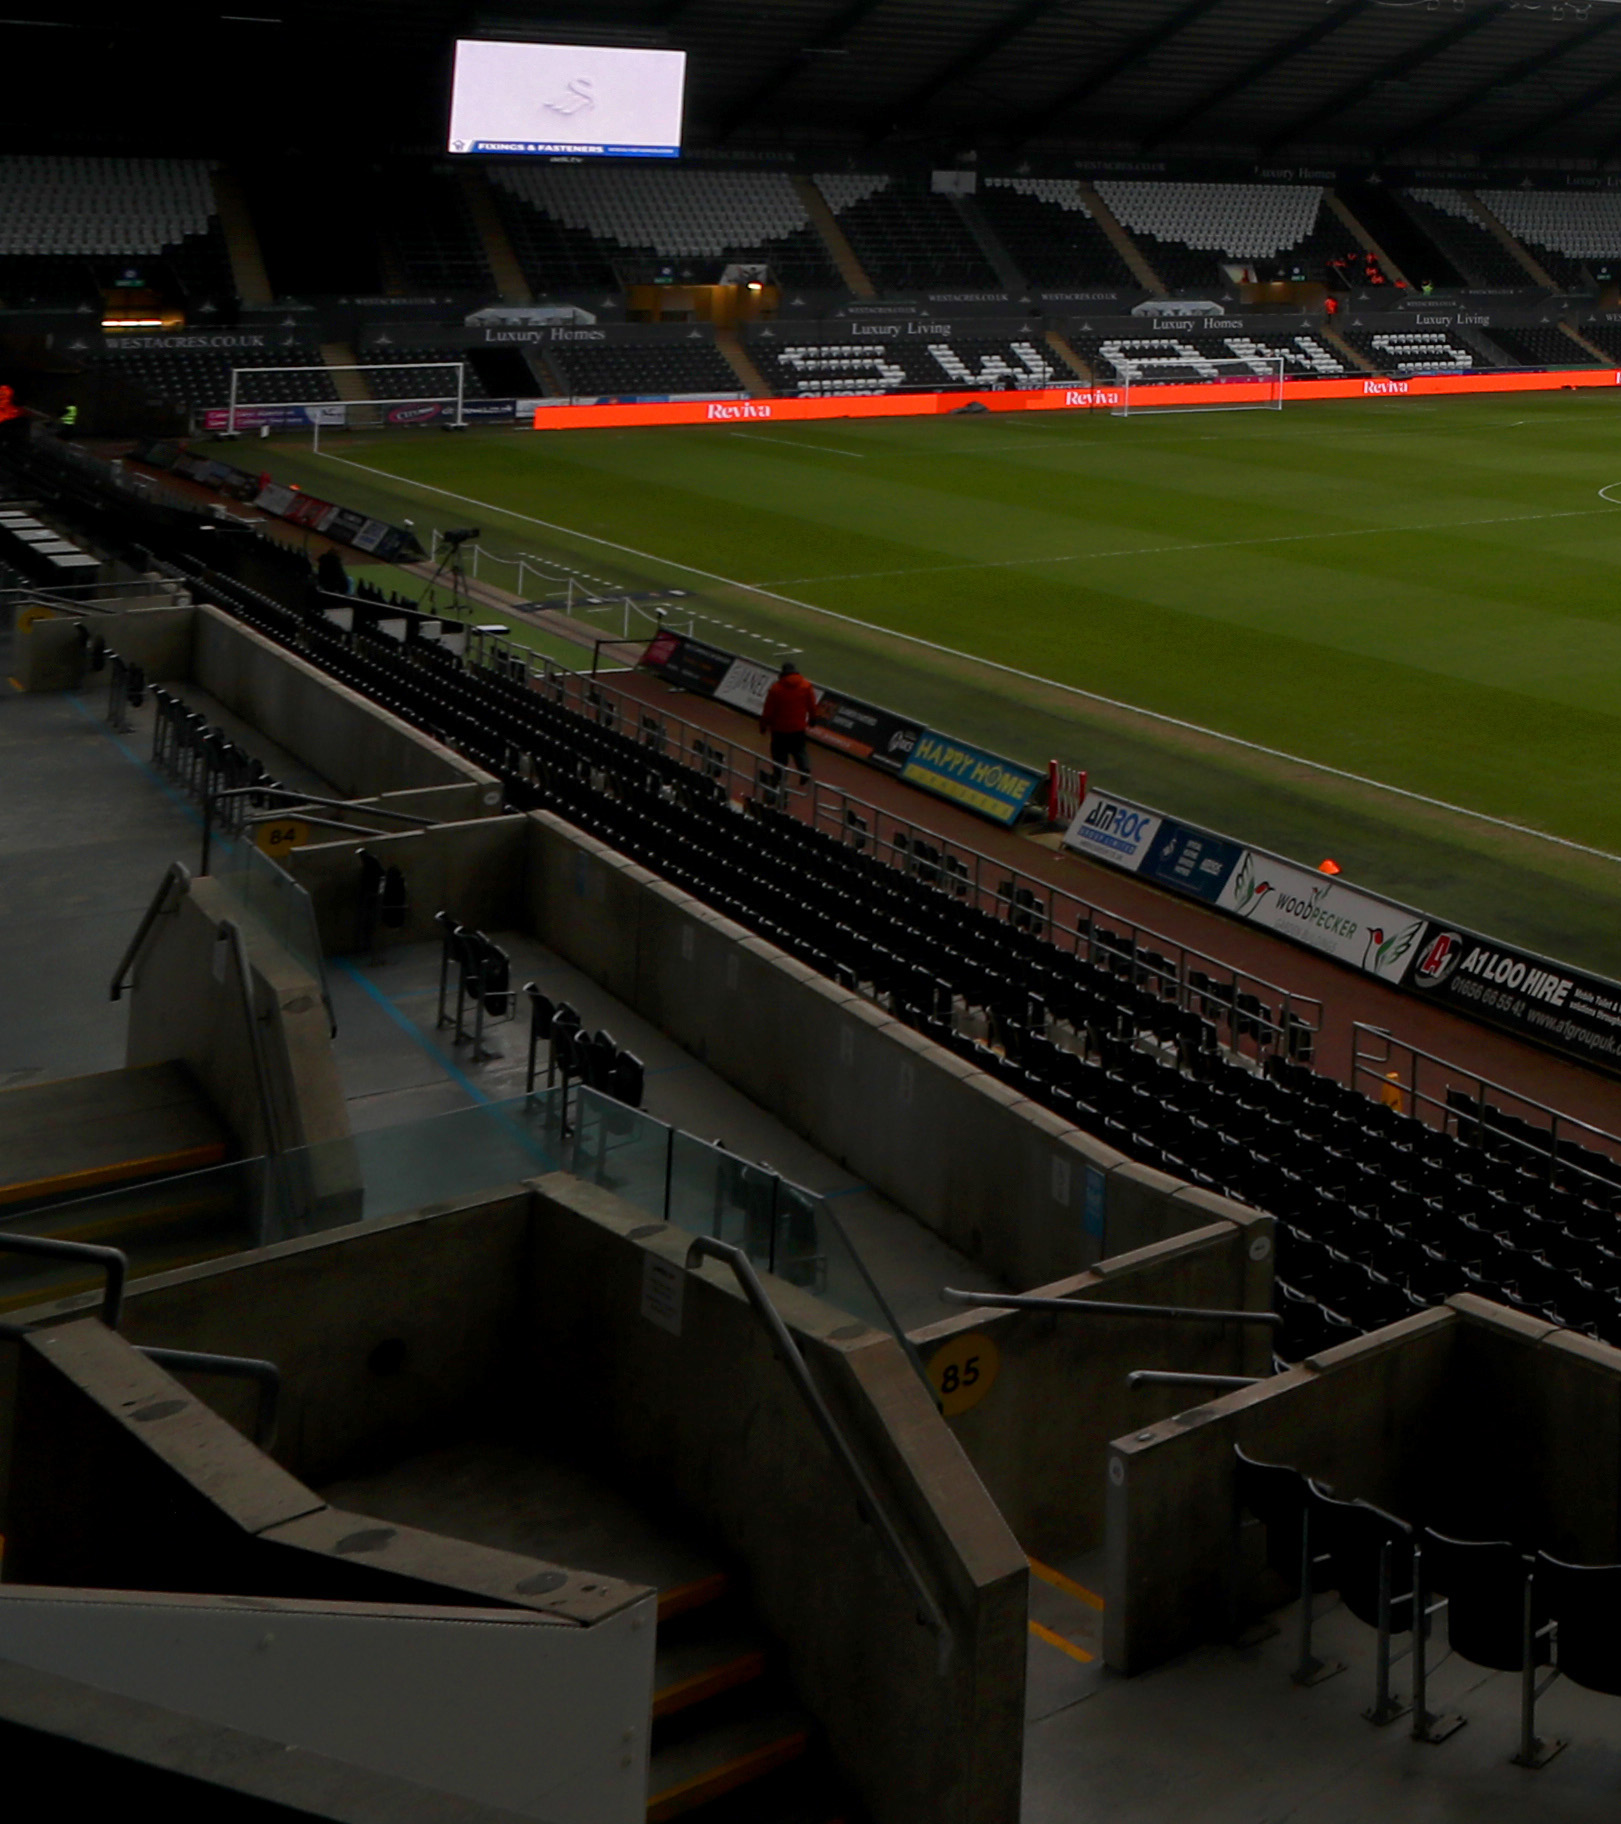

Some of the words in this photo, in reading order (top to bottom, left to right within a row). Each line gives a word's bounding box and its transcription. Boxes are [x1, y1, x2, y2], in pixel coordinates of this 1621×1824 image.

[1152, 318, 1195, 332] Luxury
[1204, 318, 1243, 330] Homes
[1416, 315, 1452, 327] Luxury
[1456, 313, 1490, 327] Living
[485, 328, 543, 344] Luxury
[551, 327, 605, 342] Homes
[852, 323, 900, 337] Luxury
[908, 322, 951, 337] Living
[106, 335, 264, 350] WESTACRES.CO.UK
[1364, 379, 1409, 395] Reviva
[1066, 389, 1118, 407] Reviva
[707, 403, 771, 420] Reviva
[914, 738, 976, 776] HAPPY
[969, 761, 1032, 801] HOME
[1277, 892, 1357, 939] WOODPECKER
[1460, 947, 1484, 975] A1
[1481, 952, 1526, 990] LOO
[1520, 966, 1574, 1008] HIRE
[1451, 975, 1484, 1005] 01656
[1482, 987, 1498, 1006] 66
[1496, 992, 1513, 1012] 55
[941, 1356, 980, 1394] 85
